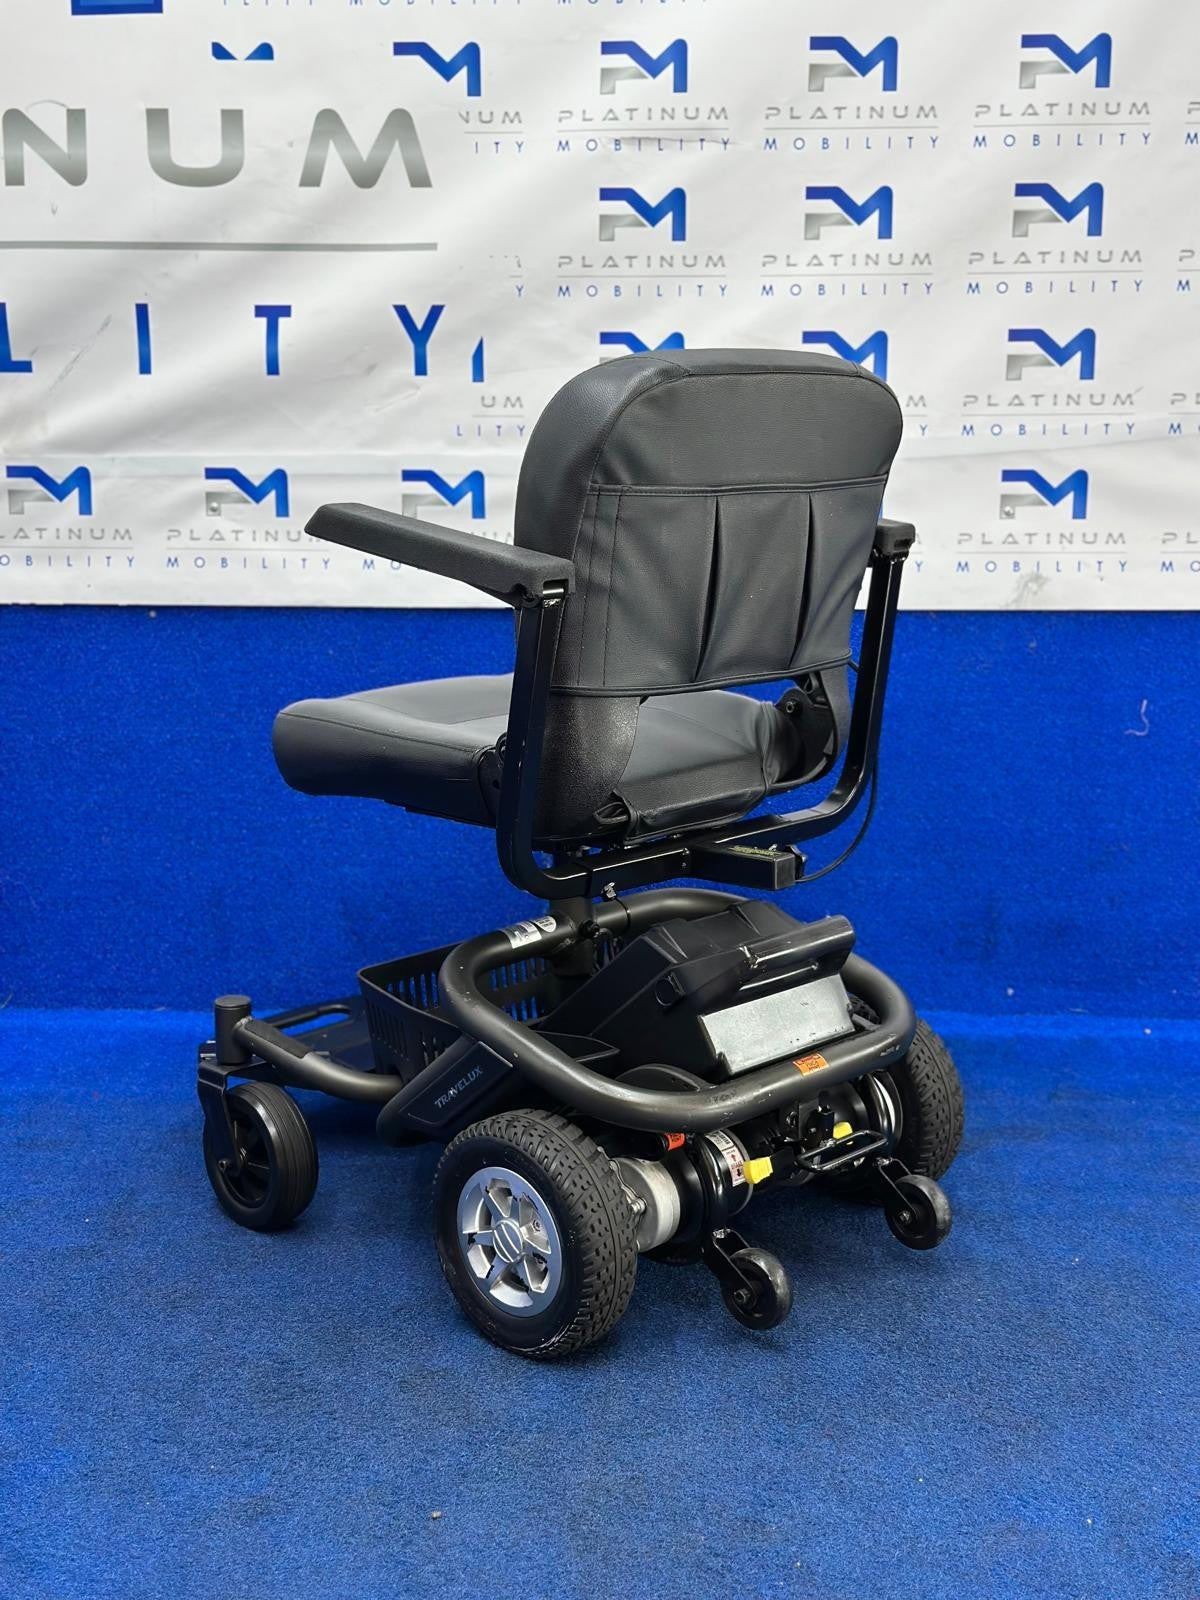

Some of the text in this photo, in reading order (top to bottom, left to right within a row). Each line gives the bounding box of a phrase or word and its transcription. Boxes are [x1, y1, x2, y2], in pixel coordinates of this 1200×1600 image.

[558, 107, 728, 122] PLATINUM
[765, 105, 937, 120] PLATINUM
[975, 102, 1150, 117] PLATINUM
[557, 139, 730, 151] MOBILITY
[764, 136, 938, 150] MOBILITY
[973, 133, 1150, 147] MOBILITY
[558, 255, 725, 268] PLATINUM
[762, 253, 932, 267] PLATINUM
[969, 250, 1141, 264] PLATINUM
[558, 285, 727, 297] MOBILITY
[761, 283, 933, 296] MOBILITY
[967, 280, 1142, 294] MOBILITY
[963, 393, 1134, 407] PLATINUM
[962, 423, 1134, 436] MOBILITY
[167, 529, 320, 543] PLATINU
[958, 533, 1125, 544] PLATINUM
[167, 557, 330, 569] MOBILITY
[956, 560, 1127, 573] MOBILITY
[434, 1065, 483, 1108] TRAVELUX
